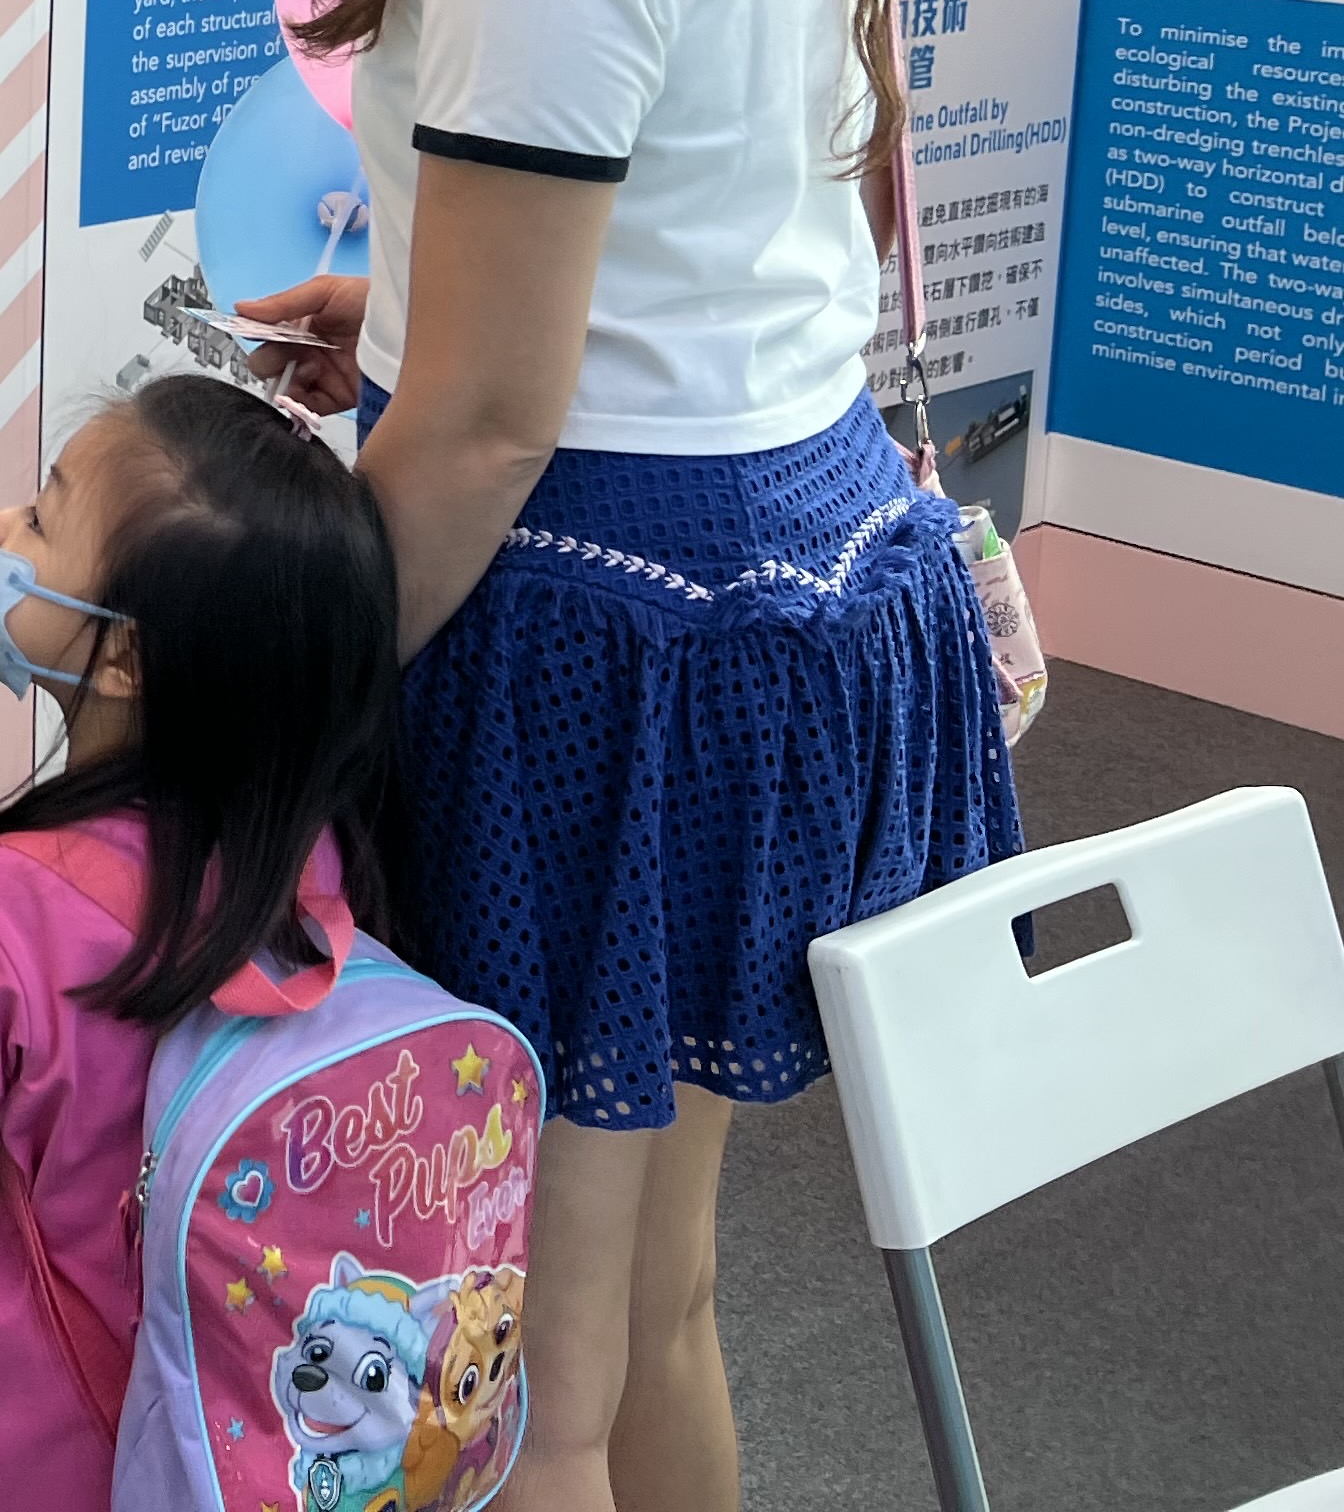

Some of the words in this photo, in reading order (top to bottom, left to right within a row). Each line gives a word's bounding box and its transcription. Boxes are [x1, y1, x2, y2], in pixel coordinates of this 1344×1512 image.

[201, 4, 276, 33] structural
[1117, 17, 1142, 36] To
[1161, 24, 1248, 48] minimise
[1267, 34, 1301, 54] the
[1115, 46, 1215, 73] ecological
[1113, 68, 1212, 100] disturbing
[938, 100, 990, 131] Outfall
[991, 98, 1009, 126] by
[1111, 98, 1237, 128] construction,
[1106, 168, 1164, 193] (HDD)
[1229, 191, 1324, 217] construct
[1103, 194, 1204, 223] submarine
[1222, 215, 1285, 236] outfall
[281, 1049, 422, 1194] Best
[369, 1102, 513, 1249] Pups
